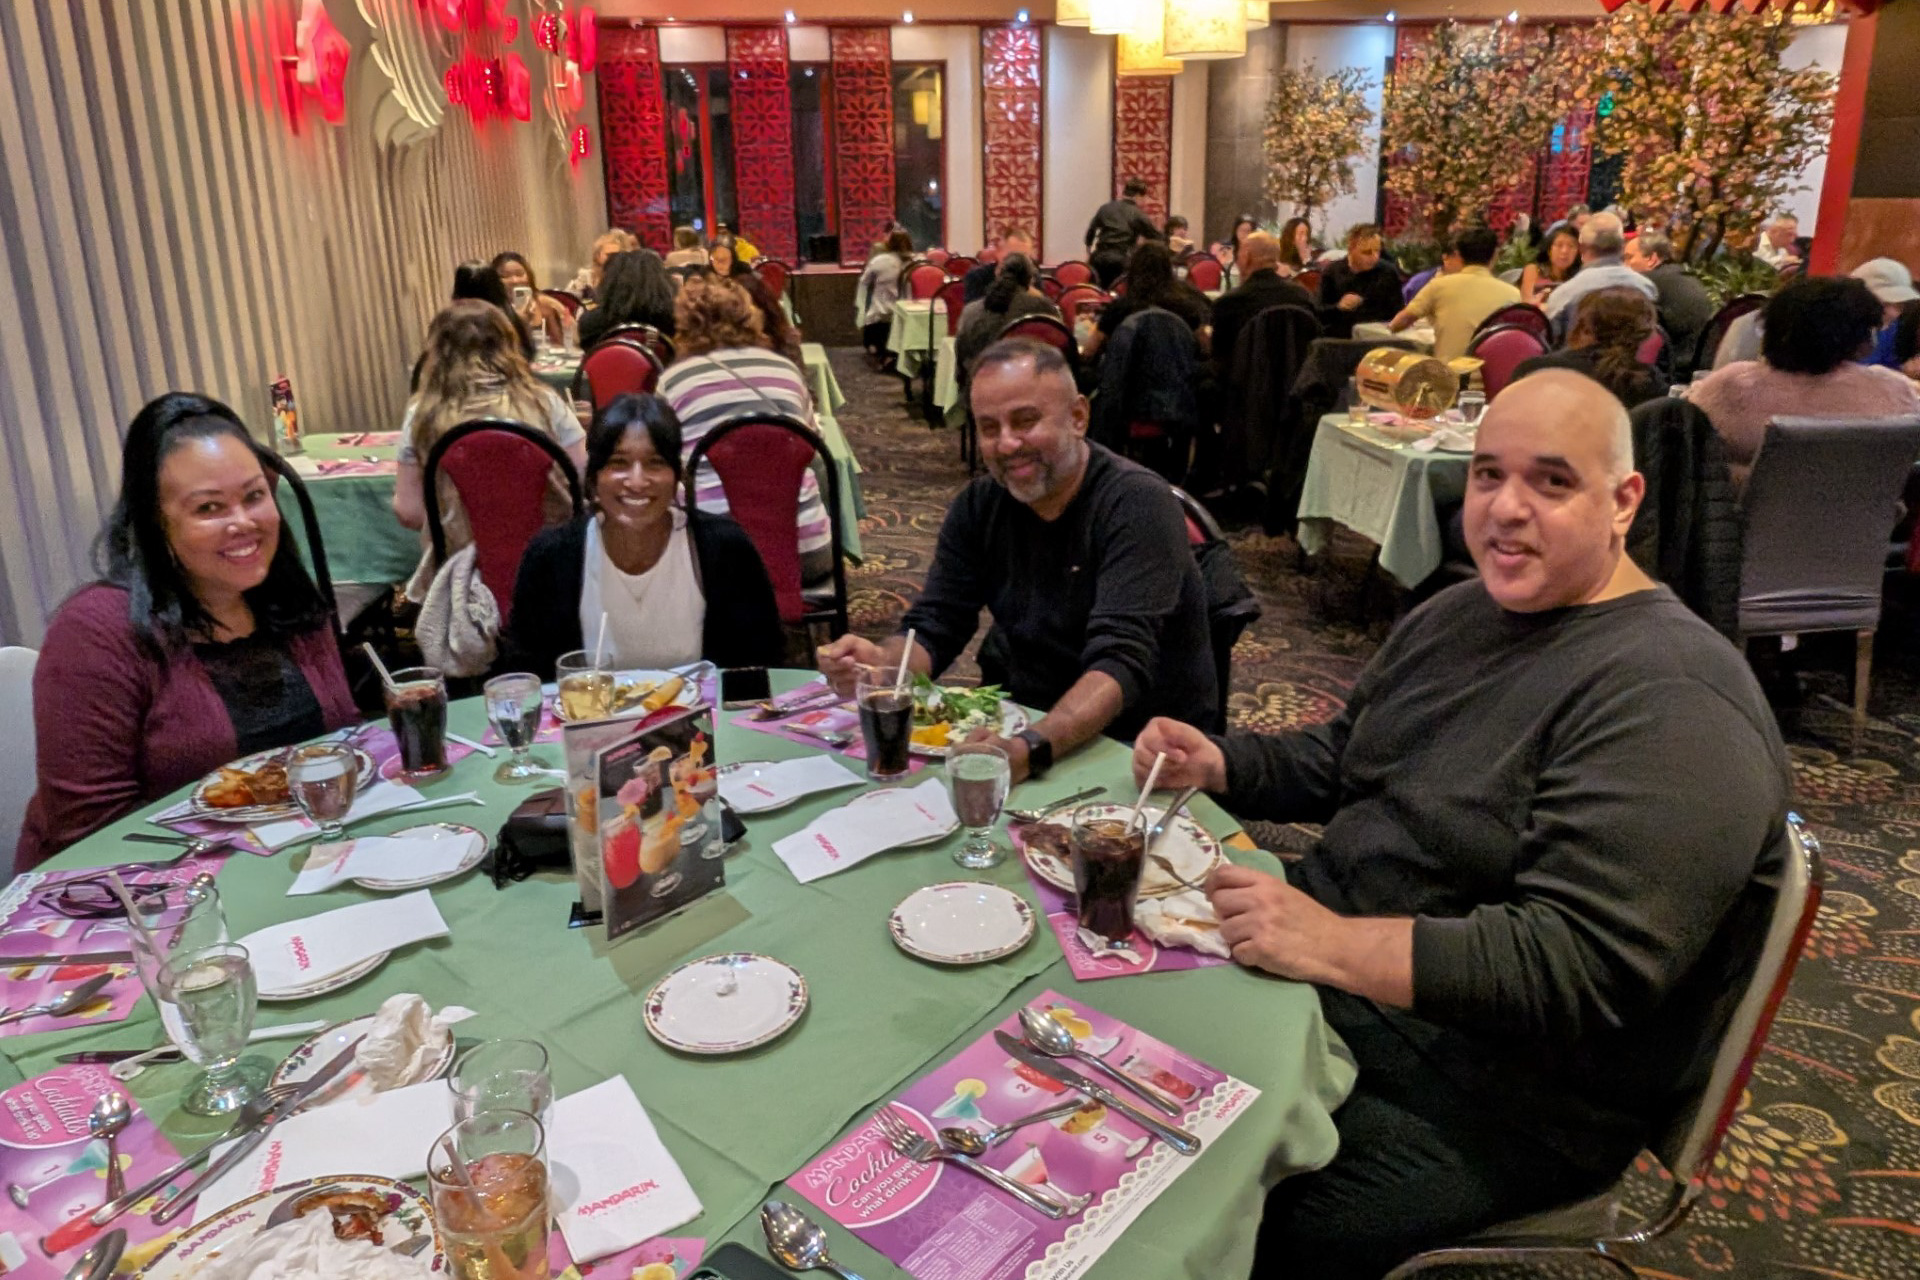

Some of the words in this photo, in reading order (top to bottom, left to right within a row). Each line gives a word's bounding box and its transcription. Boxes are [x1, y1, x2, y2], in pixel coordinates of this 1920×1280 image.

[1016, 1082, 1032, 1094] 2
[804, 1117, 891, 1189] MANDAR
[1092, 1133, 1109, 1144] 5
[577, 1179, 656, 1216] MANDARIN
[826, 1145, 904, 1207] Cockta
[852, 1191, 875, 1209] Can
[873, 1178, 893, 1195] you
[892, 1158, 918, 1179] gues
[859, 1196, 887, 1218] what
[885, 1175, 912, 1199] drink
[909, 1167, 920, 1179] it
[67, 1203, 86, 1216] 2
[178, 1211, 254, 1260] MANDARIN
